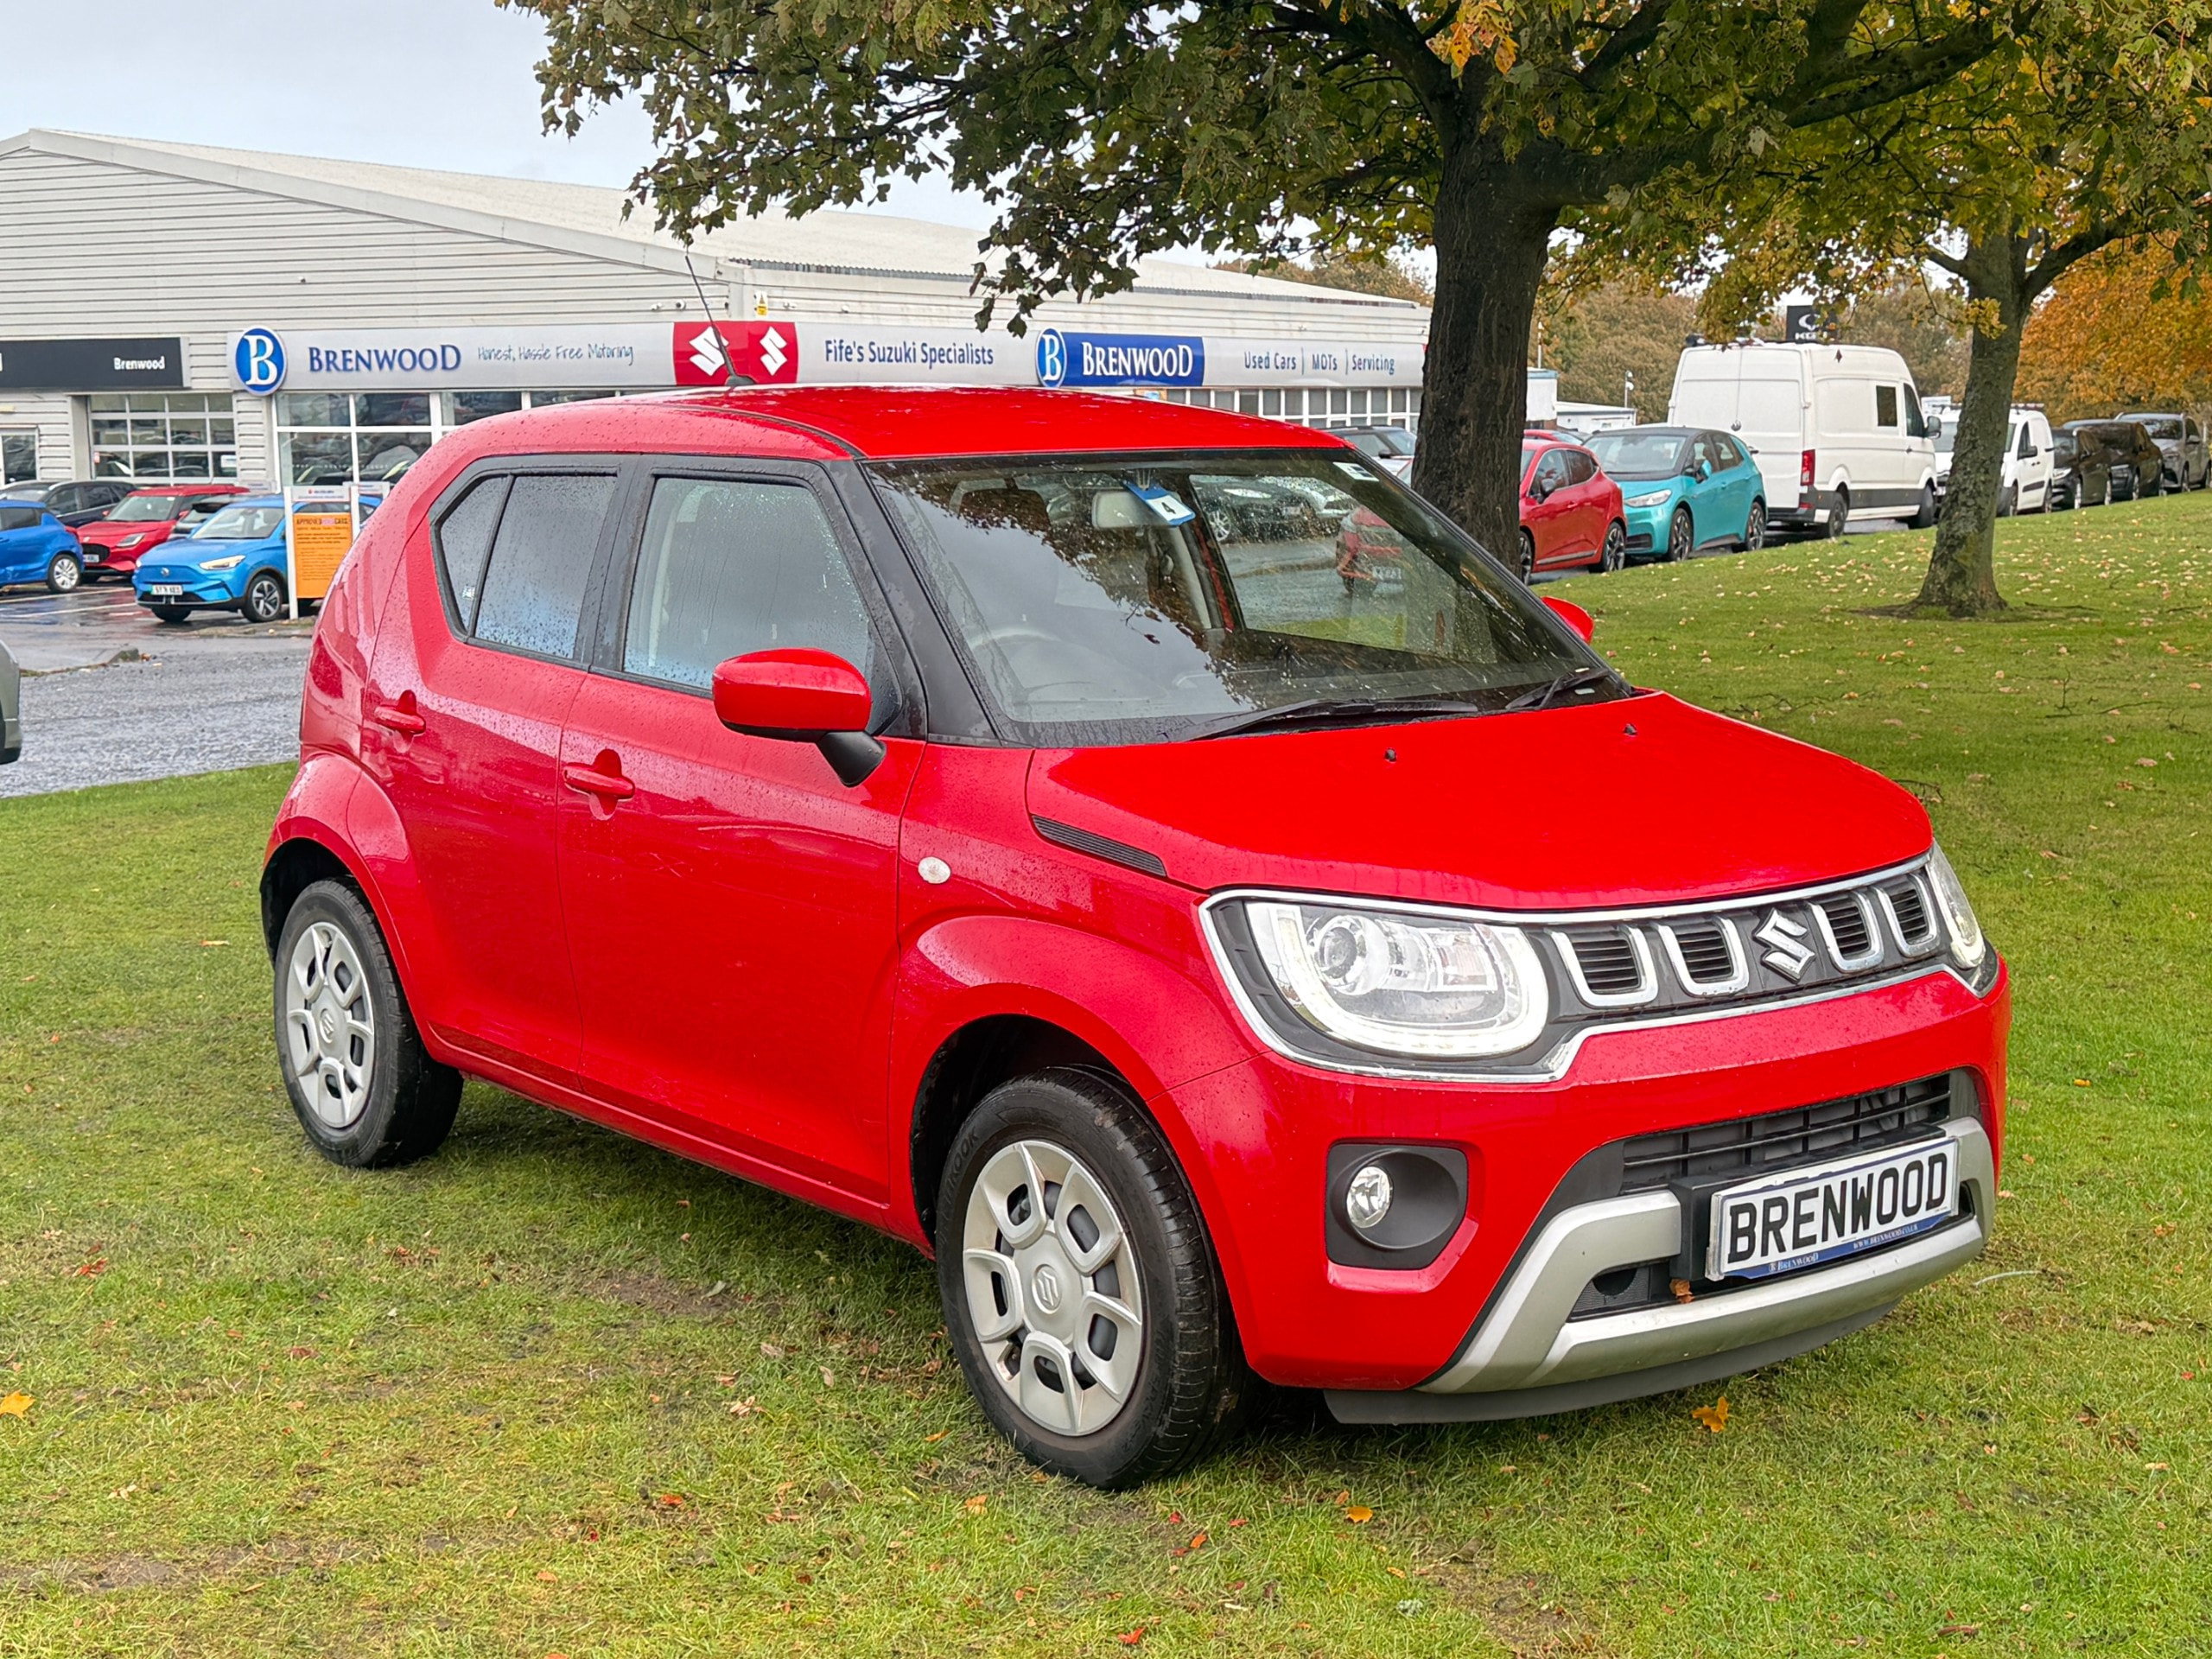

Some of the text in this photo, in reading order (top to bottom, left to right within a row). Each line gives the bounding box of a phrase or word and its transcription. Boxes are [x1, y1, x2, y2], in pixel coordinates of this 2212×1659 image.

[113, 355, 166, 371] Brenwood
[243, 334, 278, 386] B
[308, 344, 462, 373] BRENWOOD
[478, 342, 634, 366] Honest, Hassle Free Motoring
[824, 338, 994, 370] Fife's Suzuki Specialists
[1081, 341, 1194, 378] BRENWOOD
[1243, 350, 1395, 376] Used Cars MOTs Servicing
[1160, 501, 1177, 515] 4
[1727, 1152, 1948, 1264] BRENWOOD
